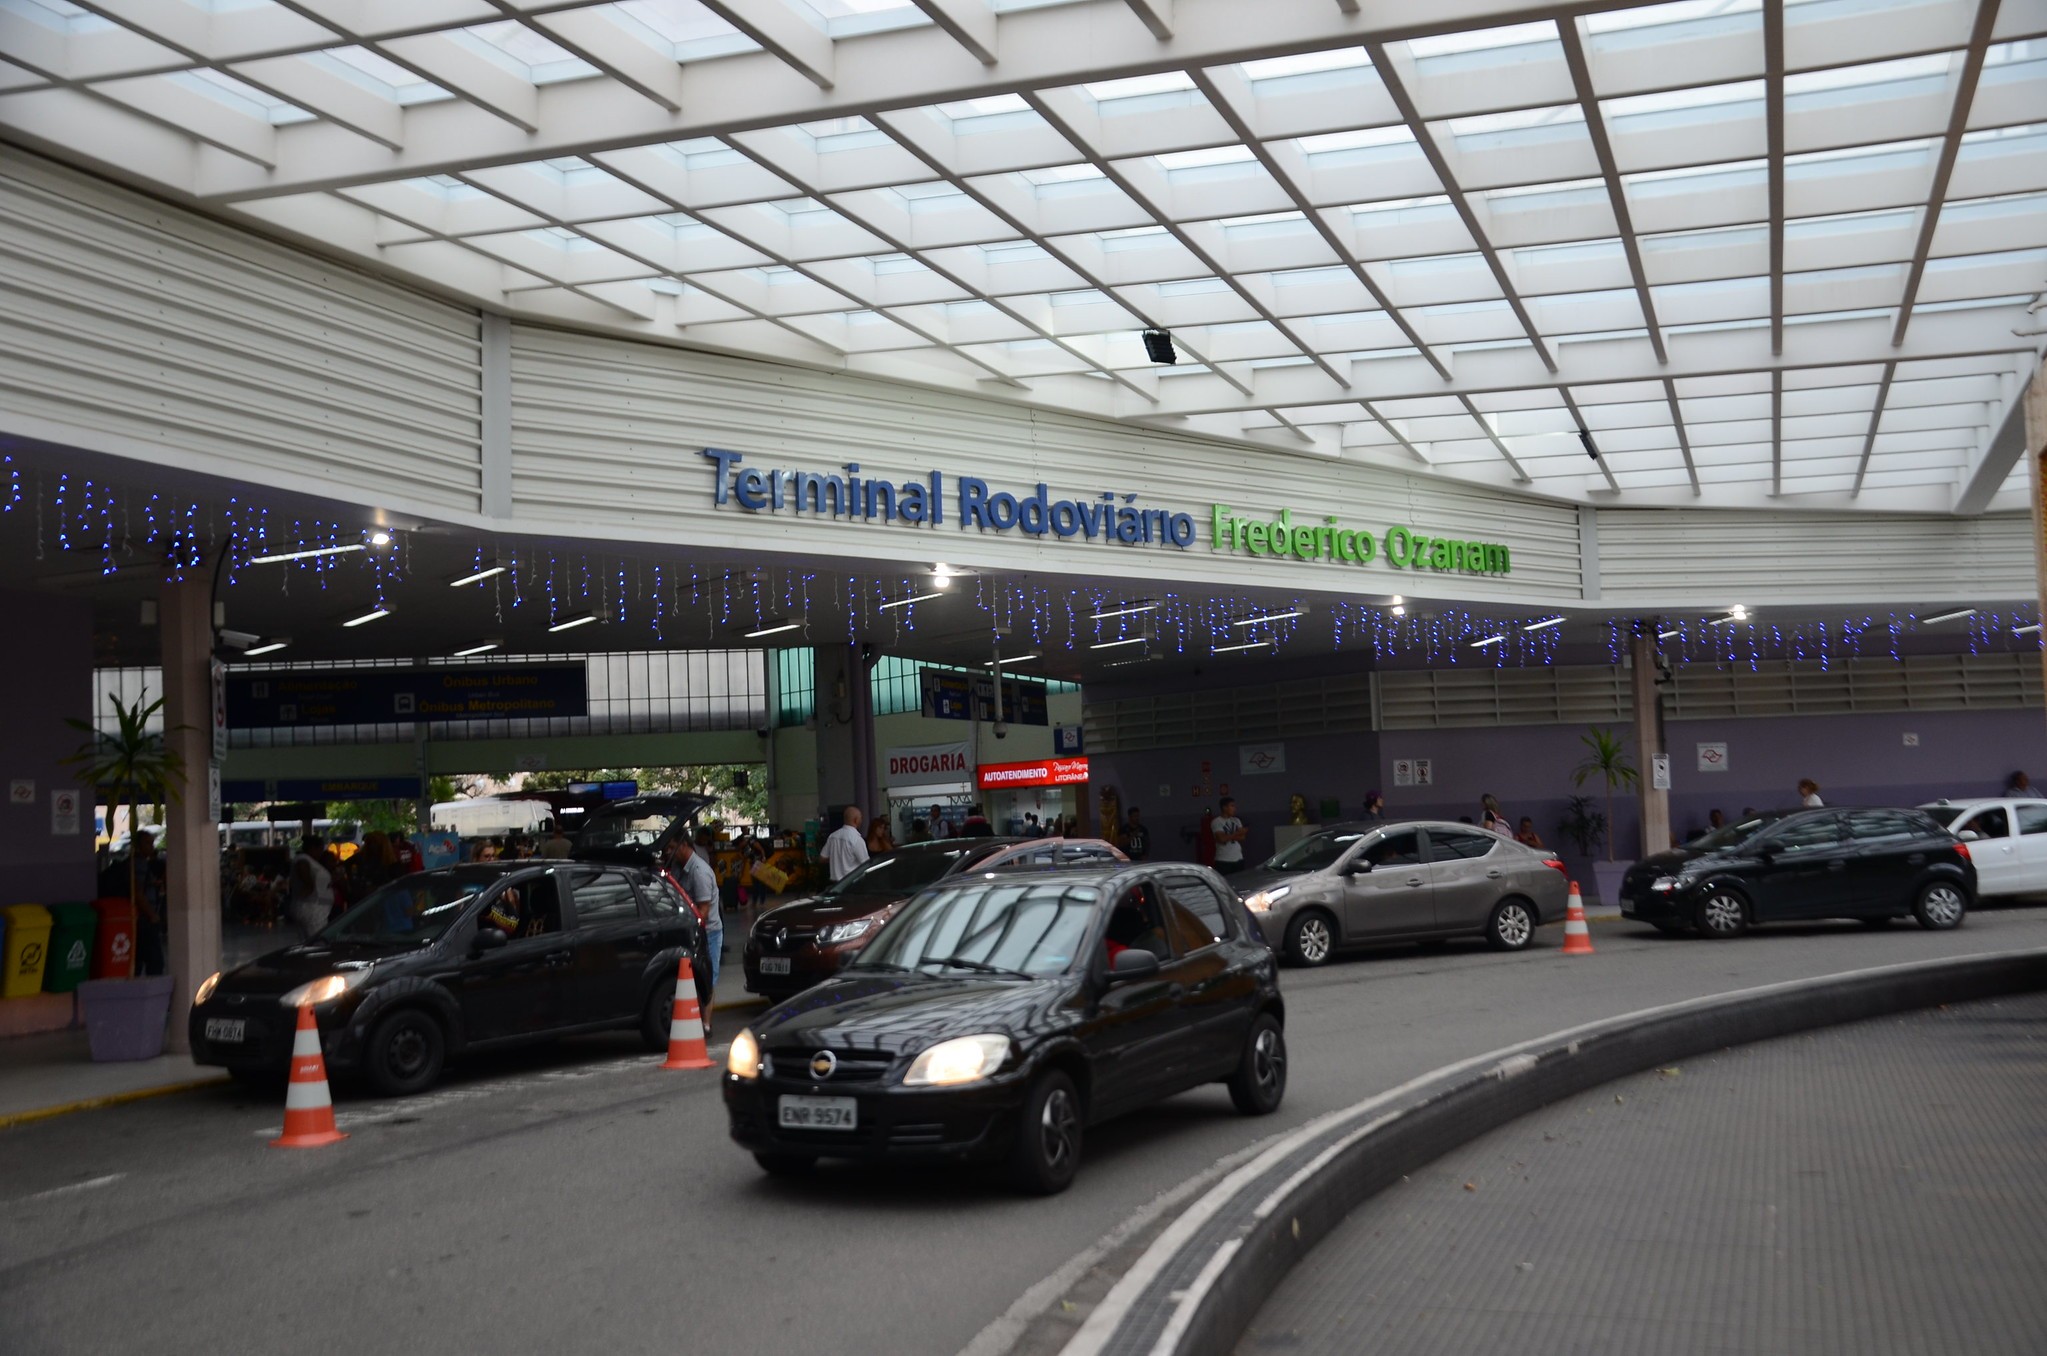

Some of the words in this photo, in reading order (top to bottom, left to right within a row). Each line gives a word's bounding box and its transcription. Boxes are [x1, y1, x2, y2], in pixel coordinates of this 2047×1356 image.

[704, 447, 943, 525] Terminal
[958, 475, 1196, 547] Rodoviário
[1212, 503, 1376, 562] Frederico
[1386, 525, 1510, 573] Ozanam
[443, 675, 488, 688] Ônibus
[492, 675, 538, 687] Urbano
[419, 700, 464, 712] Ônibus
[468, 699, 555, 712] Metropolitano
[890, 753, 966, 775] DROGARIA
[984, 767, 1048, 782] AUTOATENDIMENTO
[815, 1107, 851, 1126] 9574
